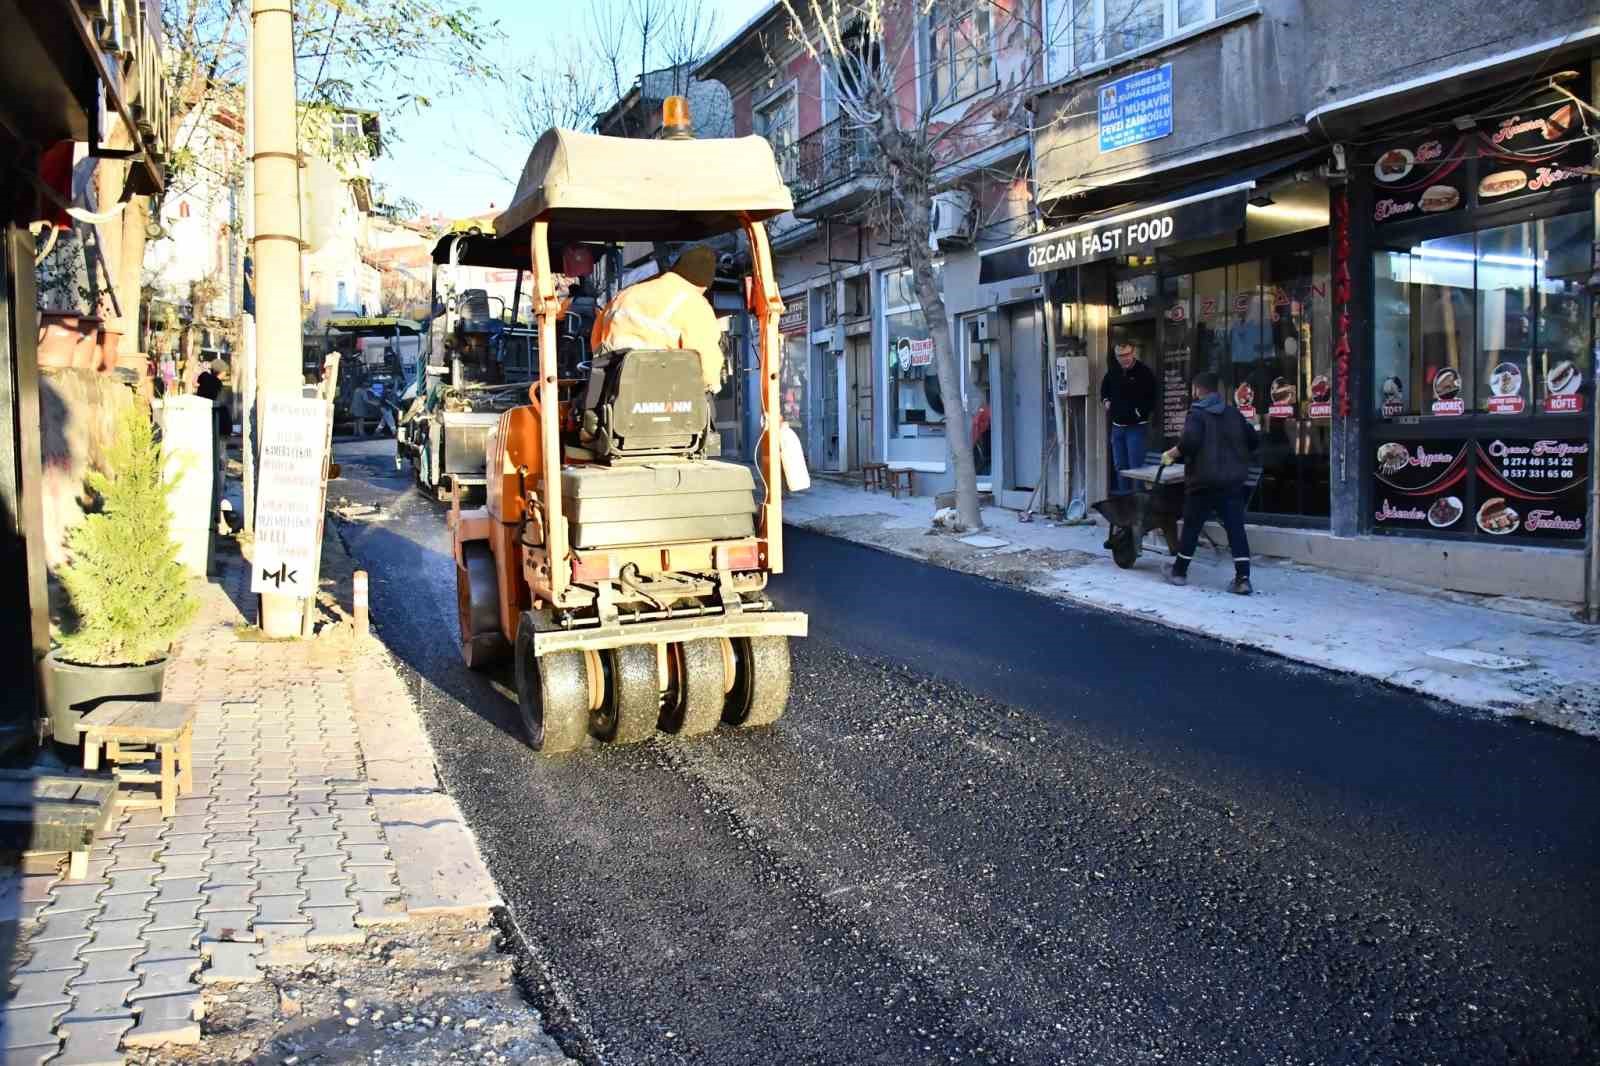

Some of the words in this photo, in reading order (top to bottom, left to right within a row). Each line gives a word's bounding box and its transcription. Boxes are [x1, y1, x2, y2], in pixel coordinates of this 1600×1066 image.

[1028, 240, 1076, 267] ÖZCAN
[1082, 229, 1122, 256] FAST
[1128, 216, 1174, 246] FOOD
[632, 400, 692, 414] AMMANN
[1551, 396, 1577, 409] KÖFTE
[1503, 458, 1509, 466] 0
[1510, 458, 1527, 466] 274
[1547, 458, 1559, 466] 54
[1561, 458, 1574, 466] 22
[1503, 469, 1509, 478] 0
